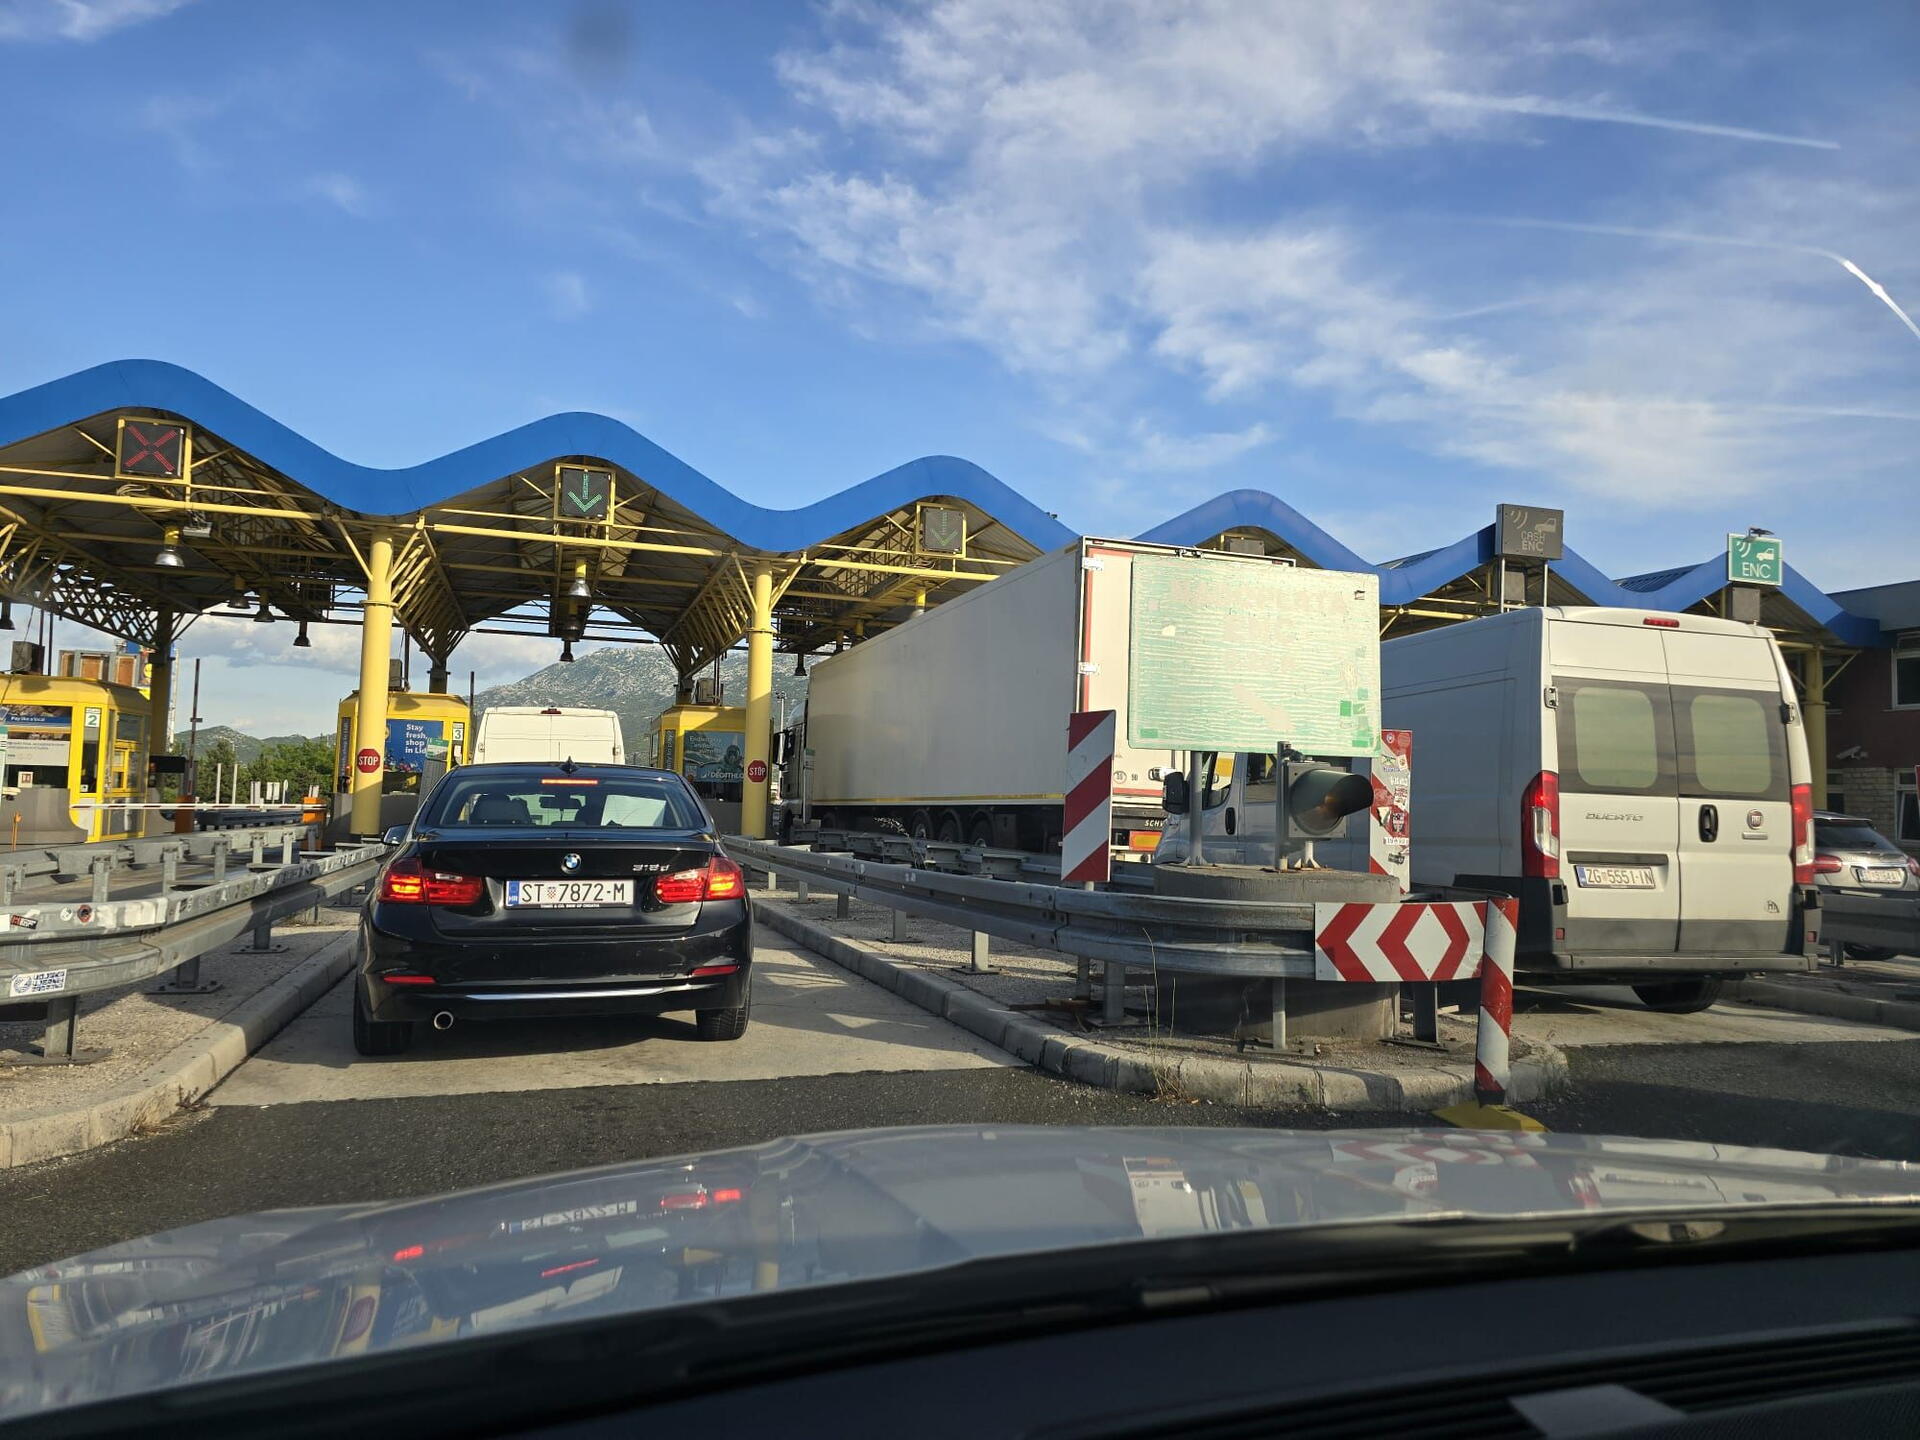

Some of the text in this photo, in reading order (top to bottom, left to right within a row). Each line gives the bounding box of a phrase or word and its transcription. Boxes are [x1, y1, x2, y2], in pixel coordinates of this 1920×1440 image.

[1521, 530, 1545, 541] CASH
[1521, 540, 1544, 552] ENC
[1742, 562, 1771, 578] ENC
[88, 714, 97, 725] 2
[406, 723, 424, 732] Stay
[405, 731, 428, 739] fresh,
[454, 729, 461, 739] 3
[405, 740, 425, 748] shop
[358, 755, 379, 766] STOP
[749, 767, 766, 776] STOP
[1585, 813, 1644, 821] DUCATO
[1586, 868, 1602, 883] ZG
[522, 883, 544, 902] ST
